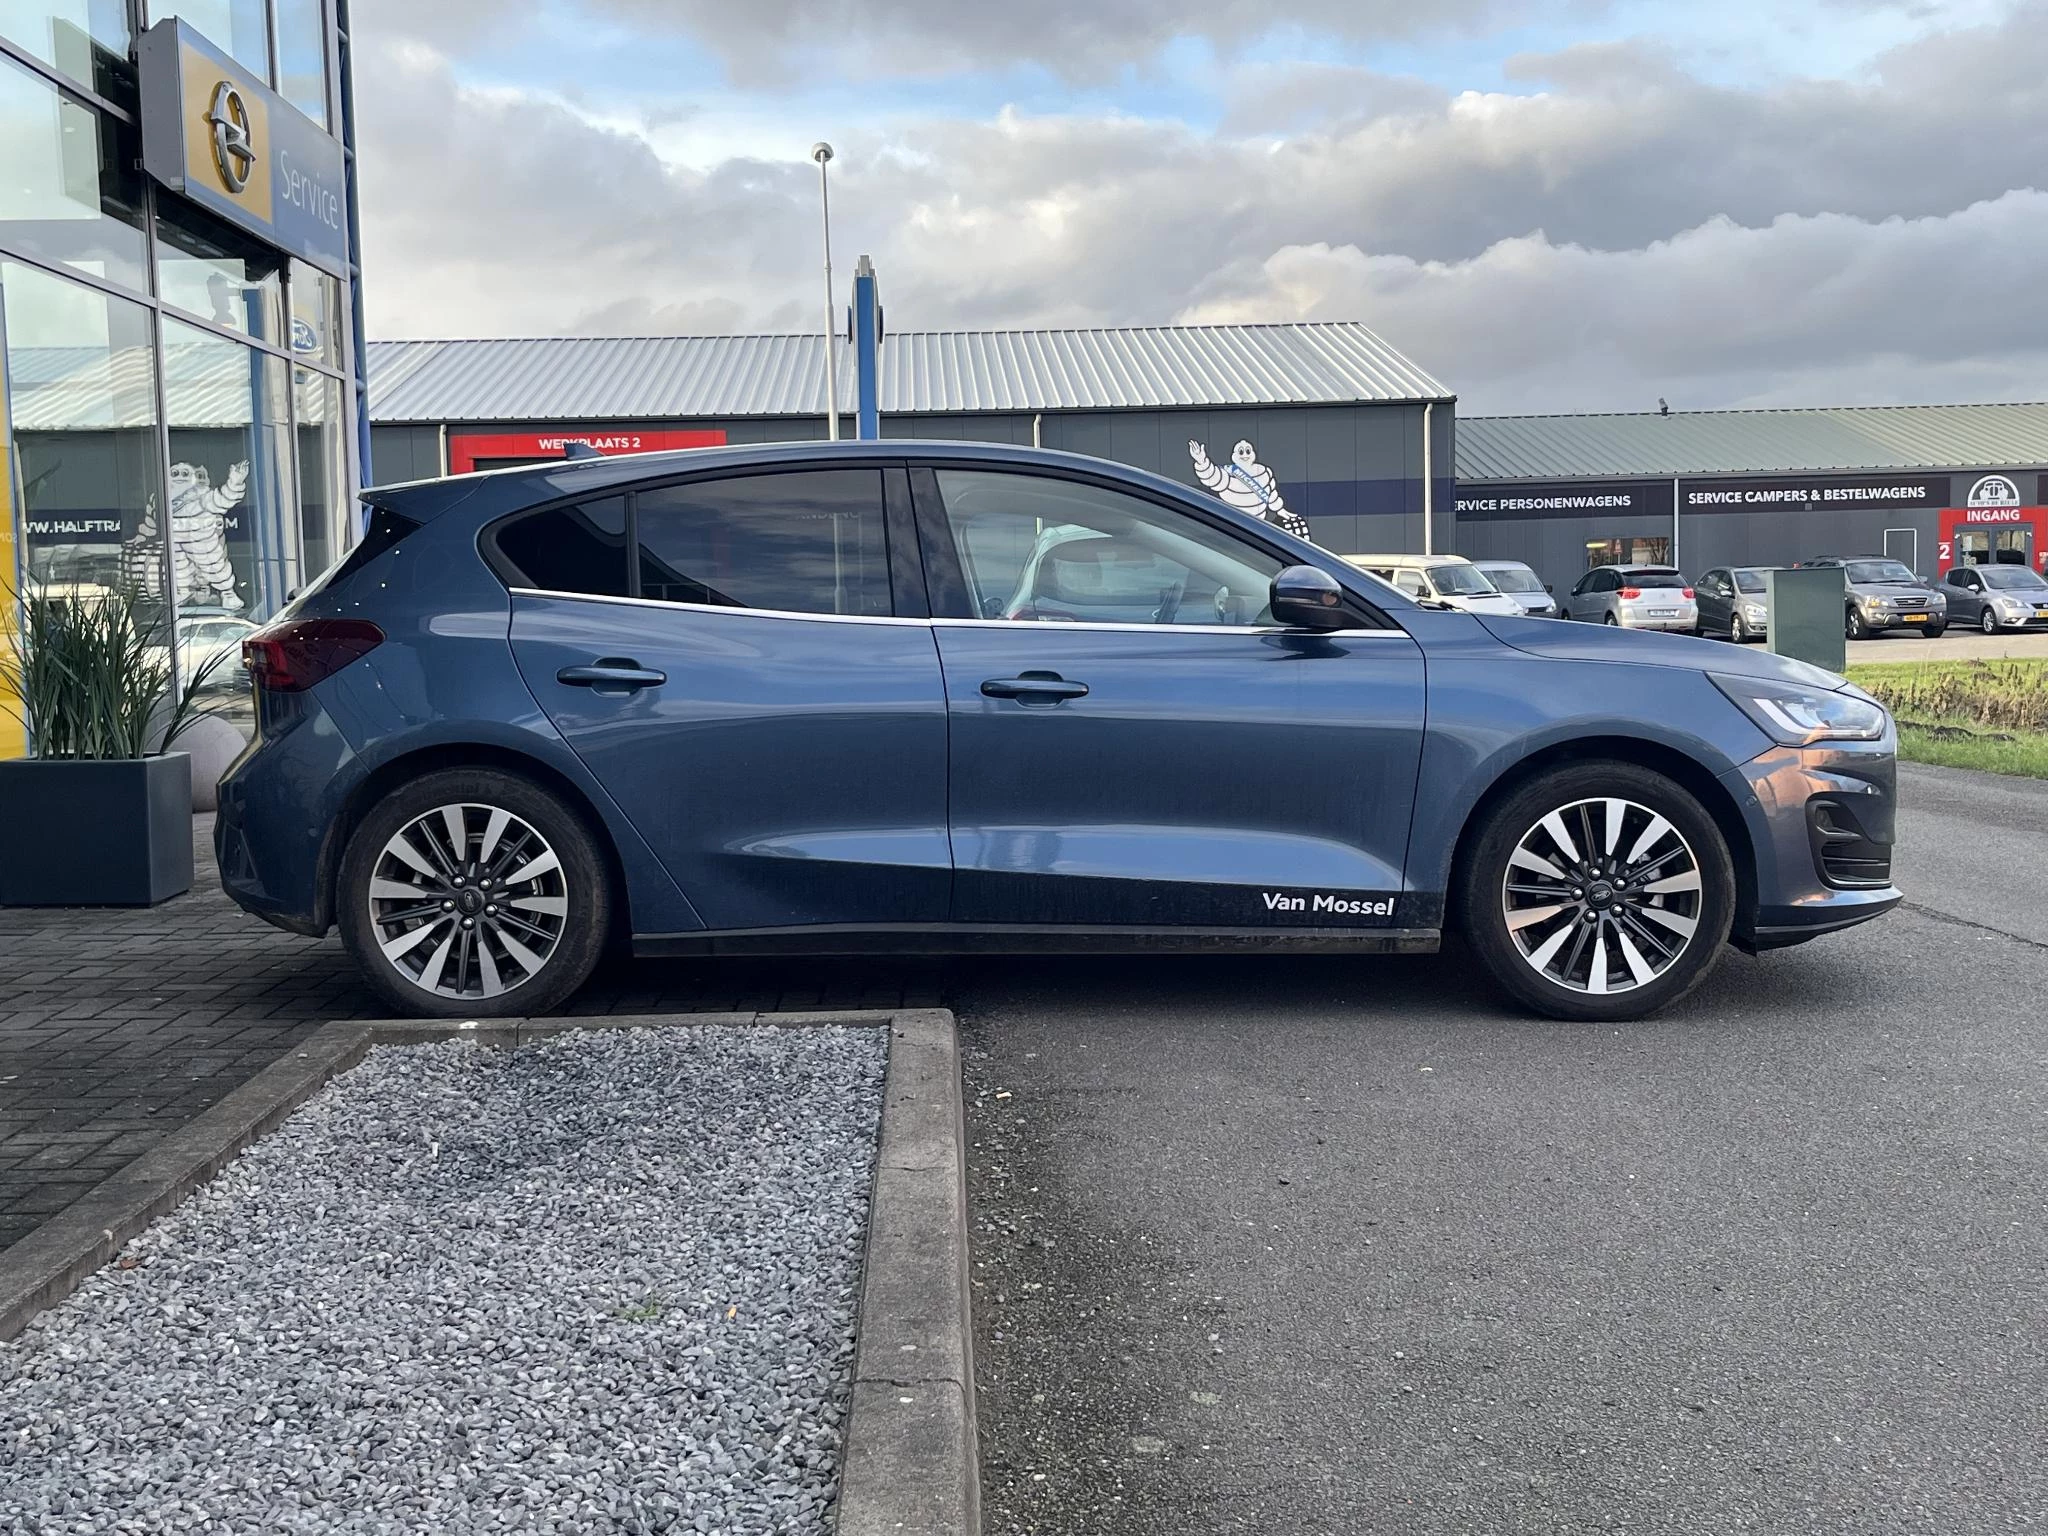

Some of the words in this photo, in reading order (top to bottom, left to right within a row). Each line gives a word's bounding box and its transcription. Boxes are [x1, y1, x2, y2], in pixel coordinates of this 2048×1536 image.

[281, 150, 338, 229] Service
[632, 437, 641, 448] 2
[1500, 495, 1631, 510] PERSONENWAGENS
[1688, 491, 1742, 504] SERVICE
[1745, 489, 1808, 502] CAMPERS
[1810, 489, 1821, 501] &
[1823, 486, 1926, 501] BESTELWAGENS
[1967, 509, 2020, 521] INGANG
[1939, 544, 1951, 559] 2
[1262, 893, 1306, 911] Van
[1312, 895, 1395, 916] Mossel
